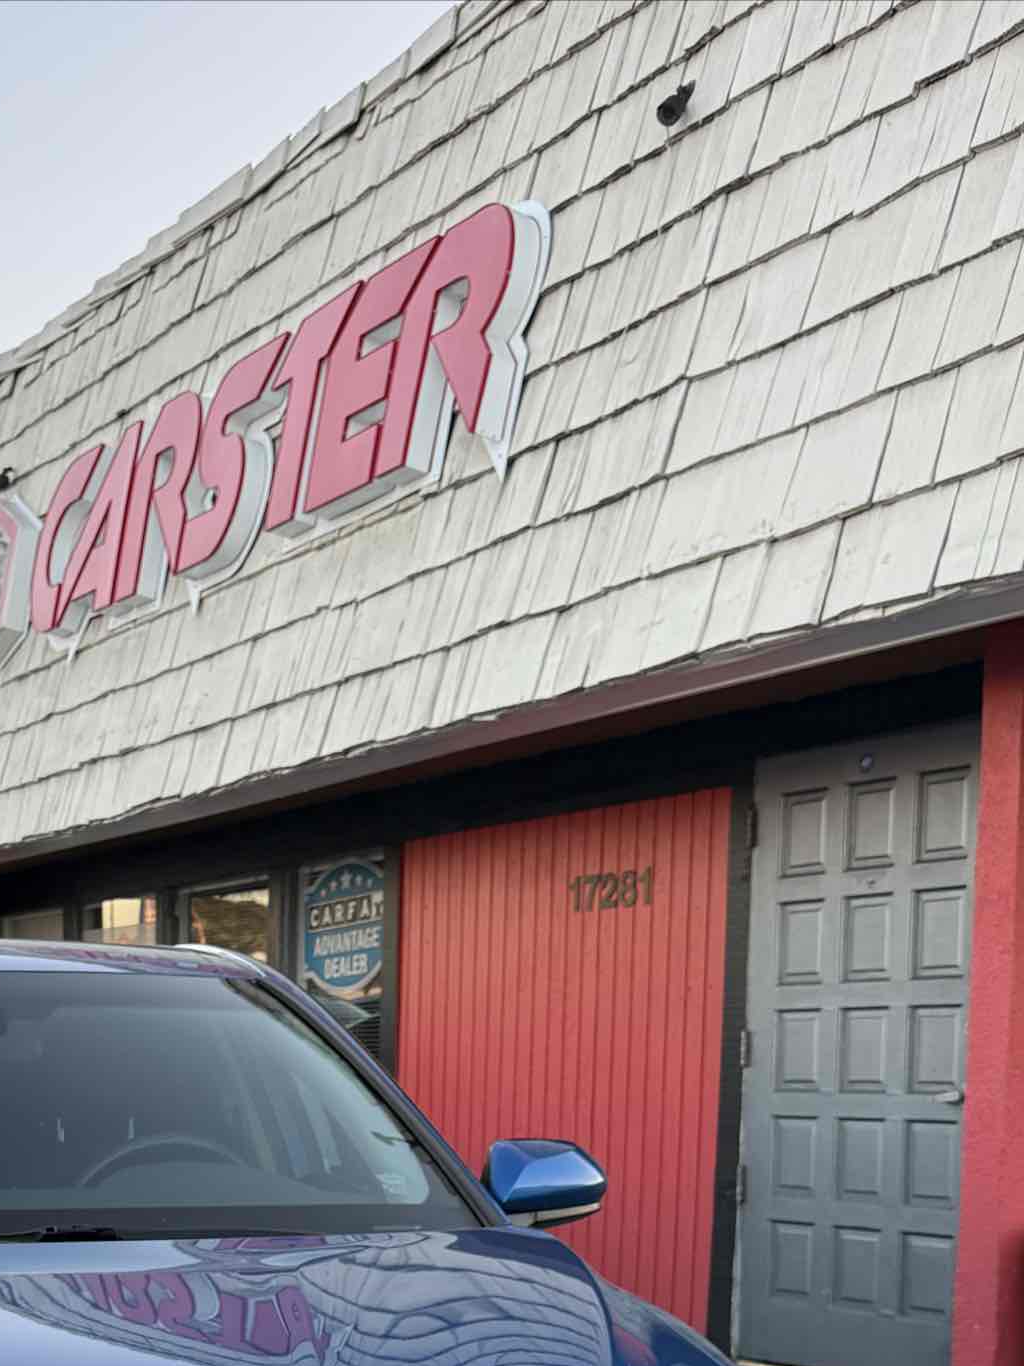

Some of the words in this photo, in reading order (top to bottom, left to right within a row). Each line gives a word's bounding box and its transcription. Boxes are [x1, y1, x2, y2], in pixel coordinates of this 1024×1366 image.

[31, 201, 538, 643] CARSTER
[567, 865, 653, 912] 17281
[313, 926, 380, 958] ADVANTAGE
[324, 953, 368, 979] DEALER
